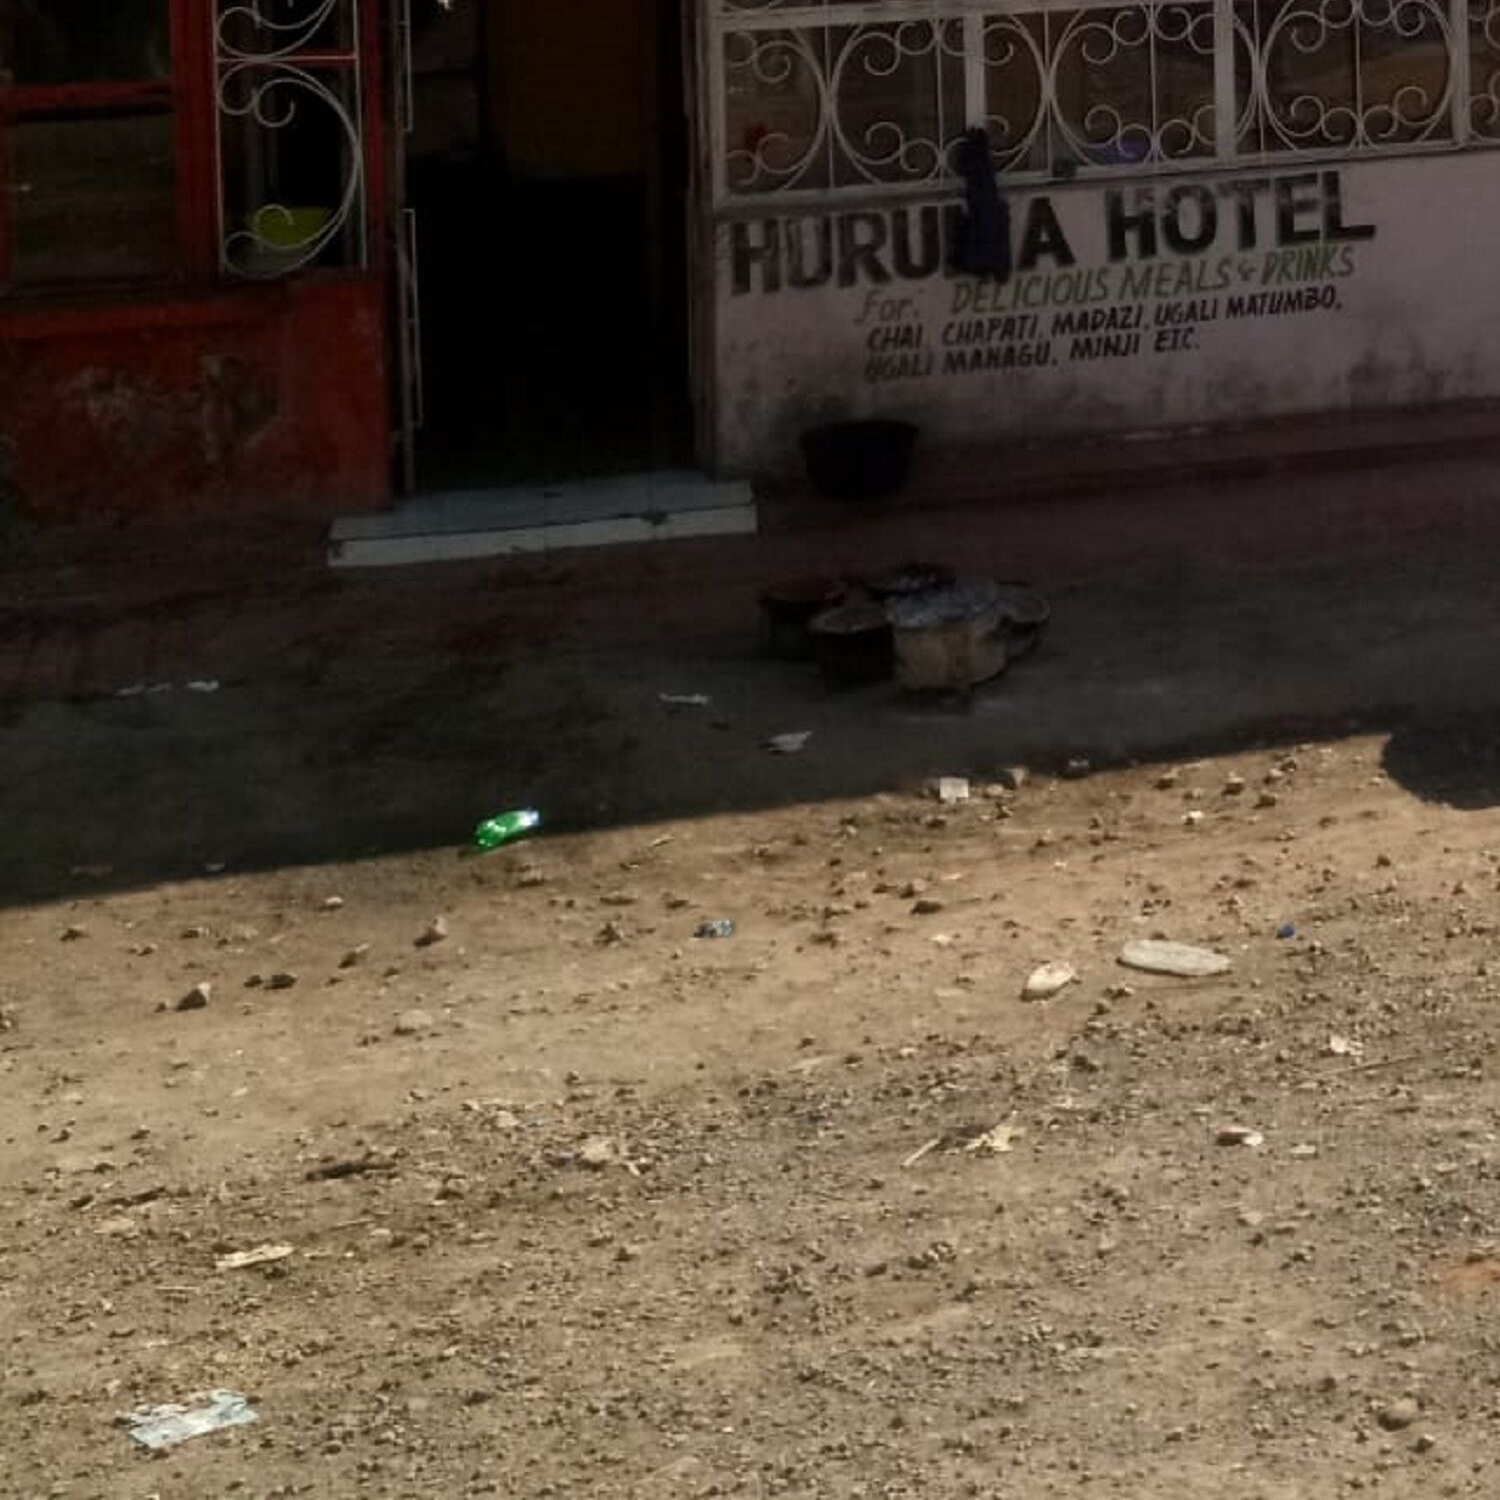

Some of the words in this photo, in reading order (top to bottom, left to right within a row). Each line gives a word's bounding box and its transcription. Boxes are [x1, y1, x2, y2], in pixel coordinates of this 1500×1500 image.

[1107, 170, 1376, 260] HOTEL
[951, 264, 1110, 315] DELICIOUS
[1118, 255, 1232, 301] MEALS
[1260, 244, 1354, 286] DRINKS
[1153, 297, 1218, 327] UGALI
[1069, 332, 1139, 361] MINJI
